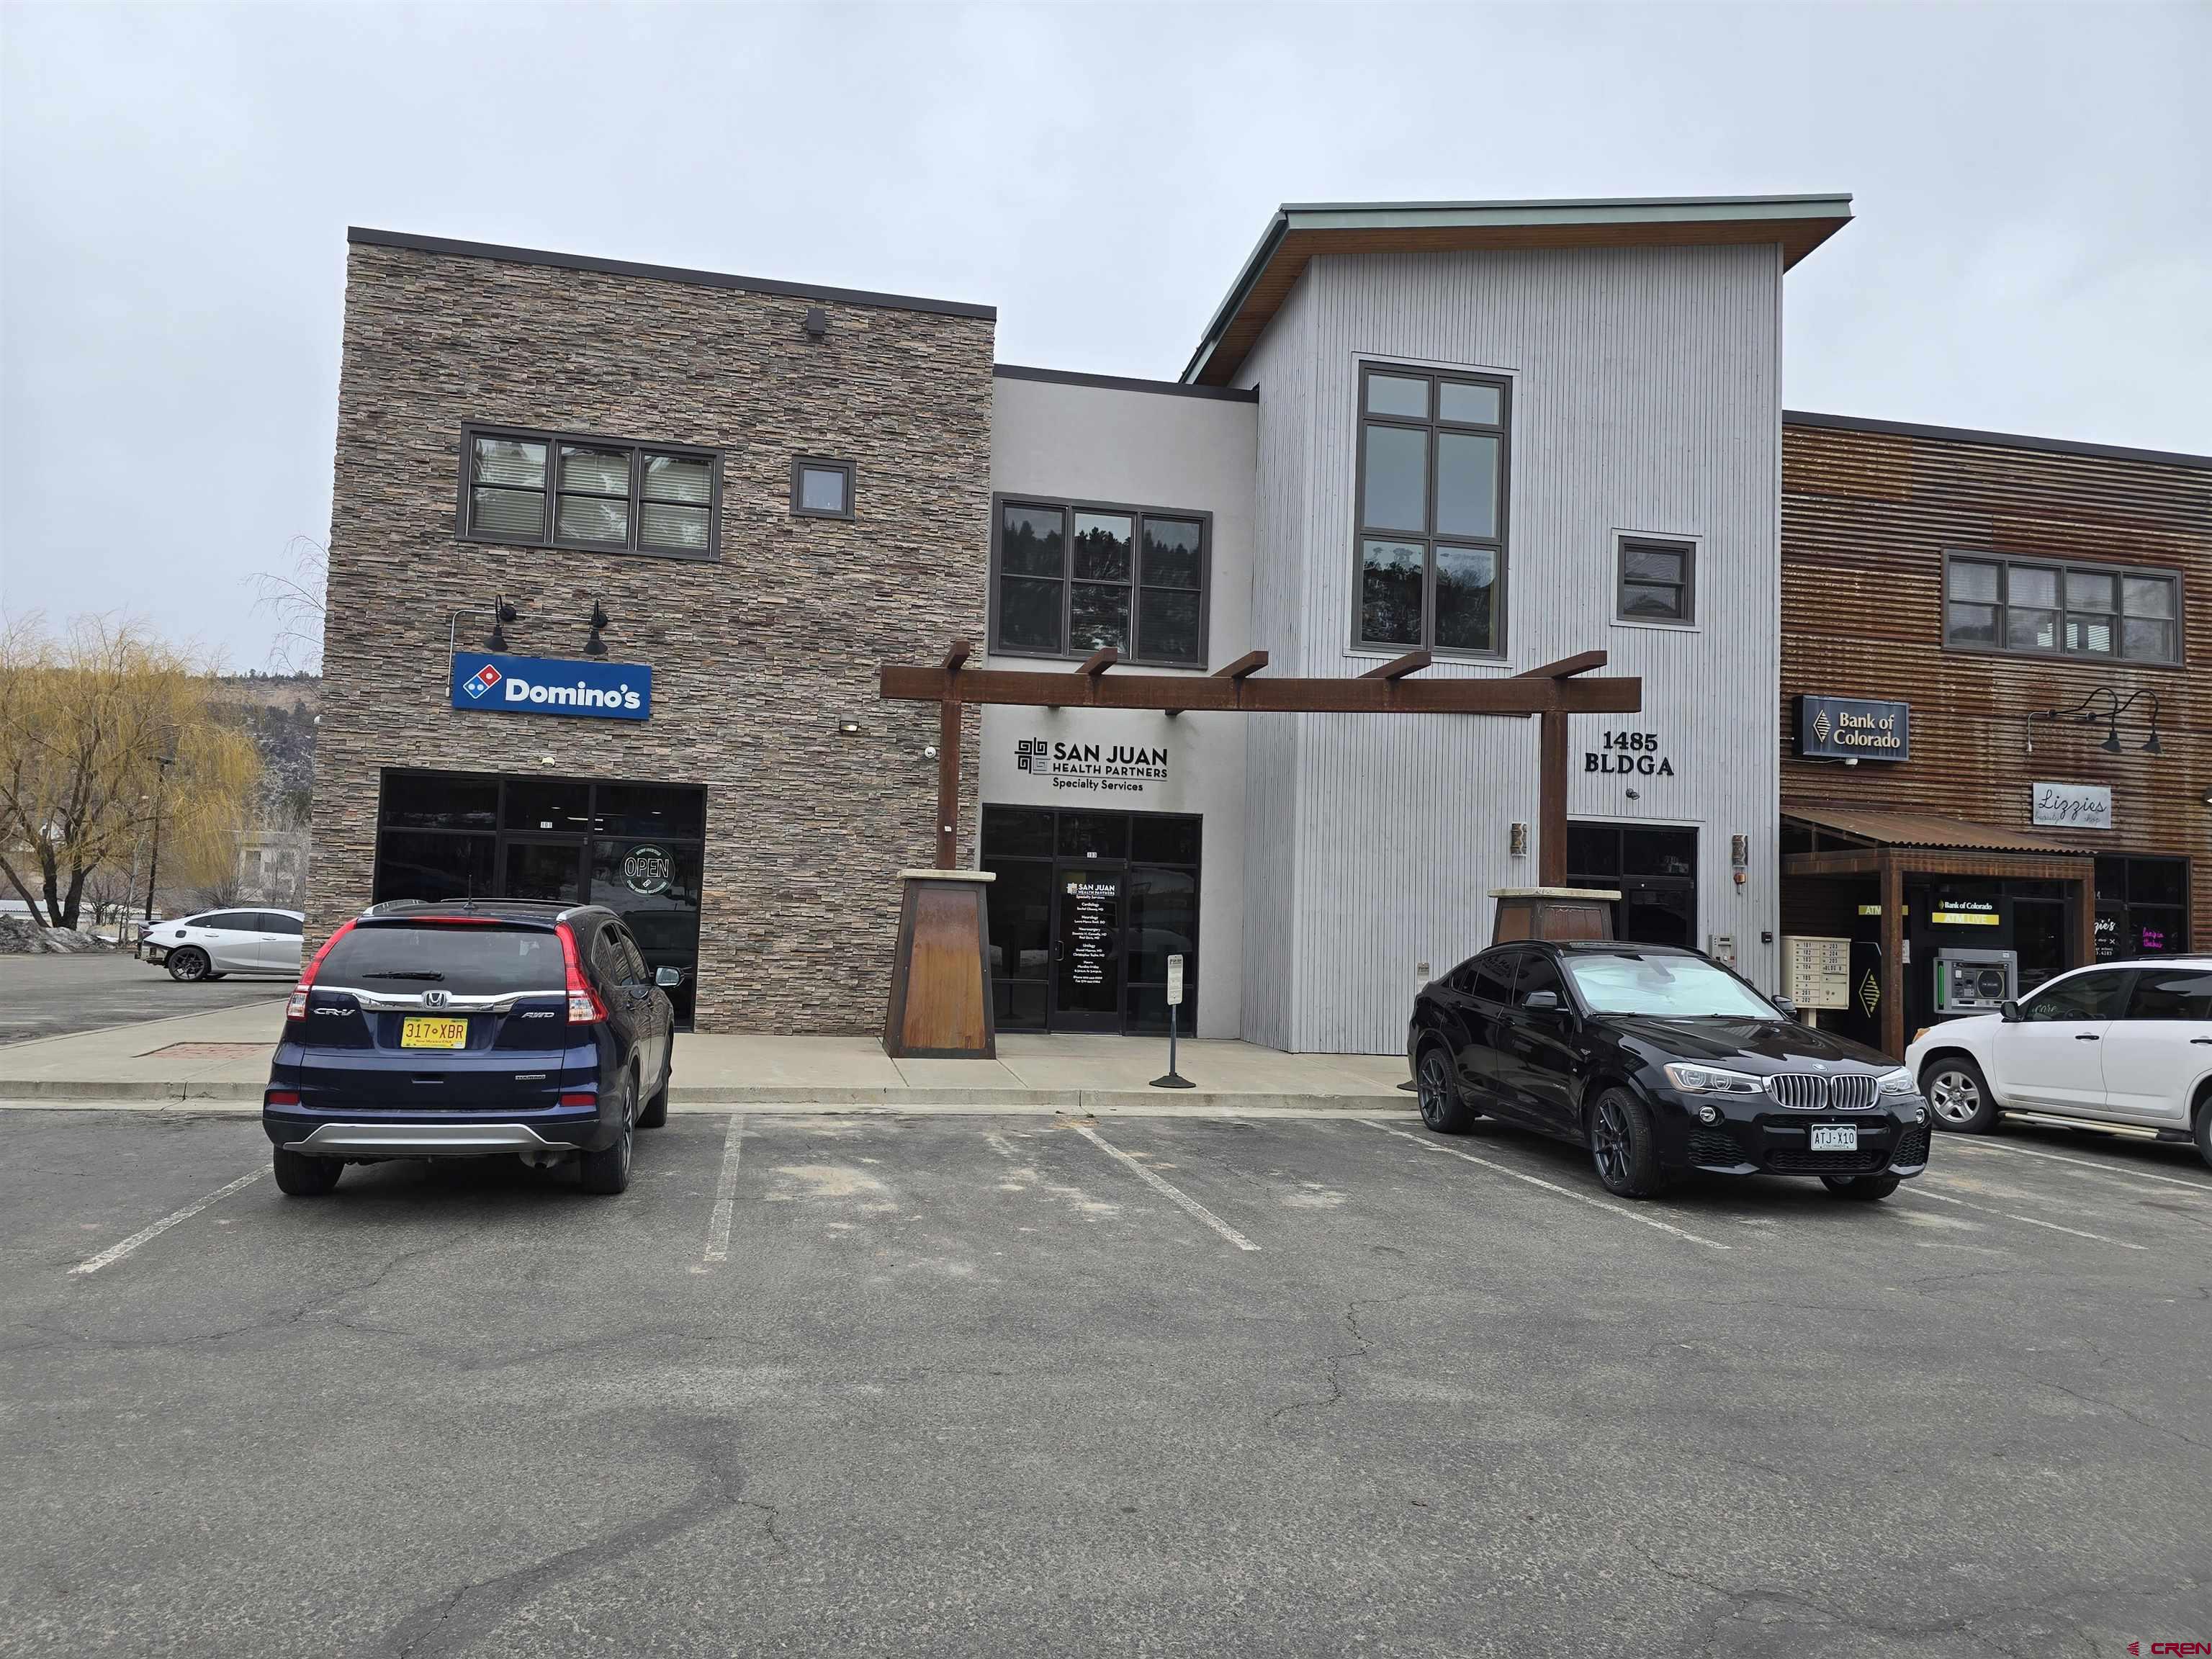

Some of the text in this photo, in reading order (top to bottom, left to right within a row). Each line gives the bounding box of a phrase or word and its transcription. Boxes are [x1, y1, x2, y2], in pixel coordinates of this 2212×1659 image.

[505, 678, 640, 709] Domino's
[1840, 712, 1894, 730] Bank of
[1604, 731, 1658, 751] 1485
[1833, 729, 1900, 748] Colorado
[1053, 742, 1167, 766] SAN JUAN
[1053, 763, 1167, 778] HEALTH PARTNERS
[1053, 777, 1143, 791] Specialty Services
[2038, 789, 2107, 820] Lizzies
[624, 857, 669, 878] OPEN
[1866, 905, 1881, 915] ATM
[1945, 914, 1964, 923] ATM
[2095, 918, 2116, 935] zie's
